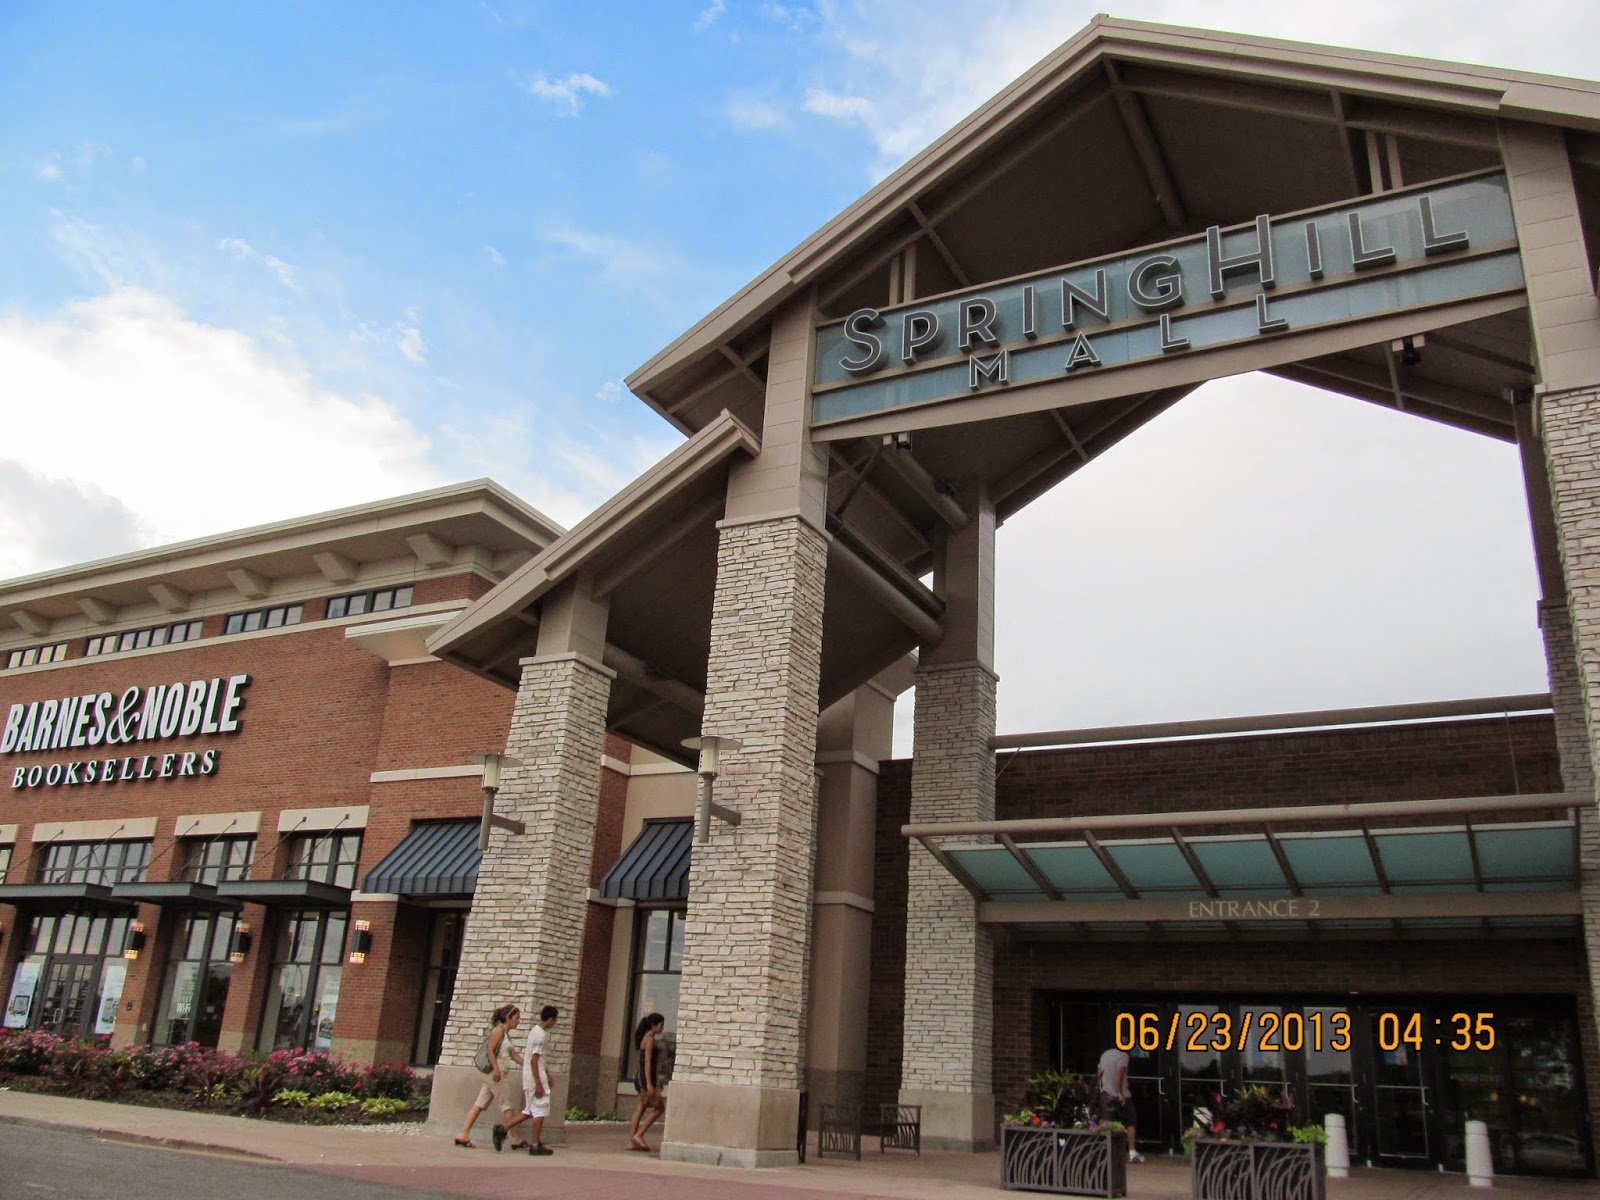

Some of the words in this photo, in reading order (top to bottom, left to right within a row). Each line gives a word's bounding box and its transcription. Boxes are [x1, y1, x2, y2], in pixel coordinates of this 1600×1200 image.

[839, 197, 1469, 376] SPRINGHILL
[968, 293, 1289, 391] MALL
[11, 750, 217, 789] BOOKSELLERS
[1189, 899, 1299, 918] ENTRANCE
[1307, 899, 1321, 916] 2
